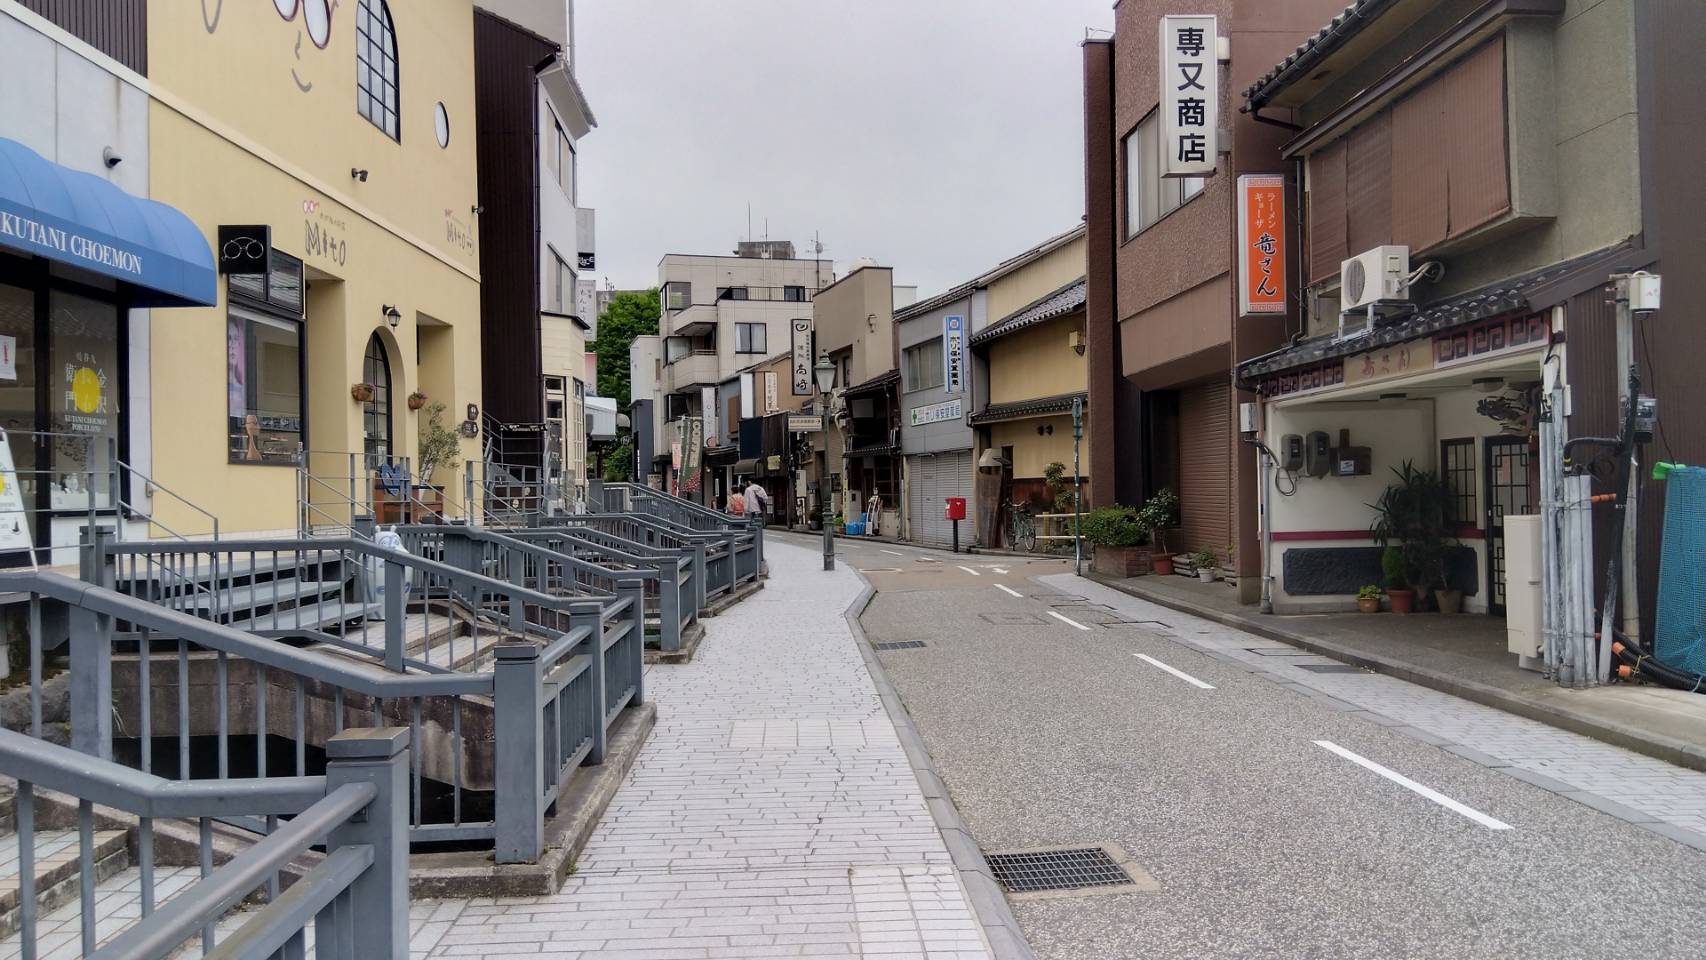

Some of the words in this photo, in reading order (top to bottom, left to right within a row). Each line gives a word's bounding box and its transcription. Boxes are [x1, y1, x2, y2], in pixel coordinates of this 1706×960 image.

[1177, 27, 1206, 163] 専又商店
[1255, 192, 1264, 229] ギョーザ
[1267, 192, 1276, 229] ラーメン
[0, 211, 67, 252] KUTANI
[70, 235, 143, 275] CHOEMON
[1253, 232, 1278, 296] 竜さん
